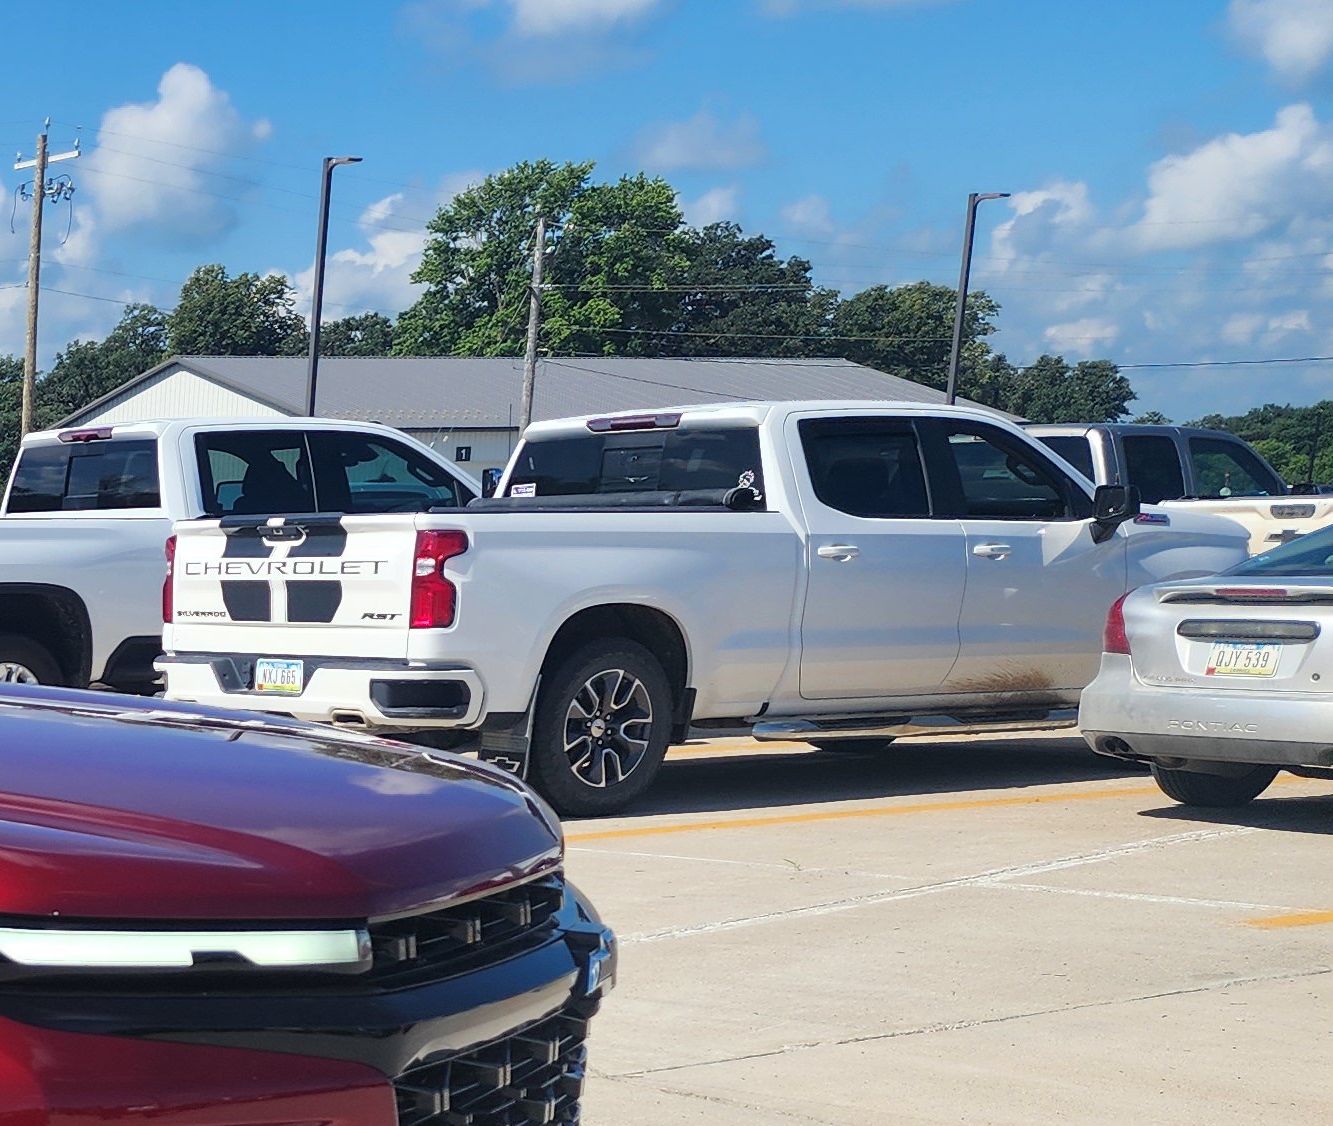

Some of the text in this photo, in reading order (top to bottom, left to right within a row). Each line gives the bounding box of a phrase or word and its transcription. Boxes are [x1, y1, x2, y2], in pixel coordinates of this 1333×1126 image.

[460, 448, 467, 460] 1
[185, 560, 389, 576] CHEVROLET
[176, 610, 227, 618] SILVERADO
[361, 612, 403, 621] RST
[1215, 650, 1270, 668] QJY 539
[262, 668, 296, 685] NXJ 665
[1166, 719, 1259, 733] PONTIAC
